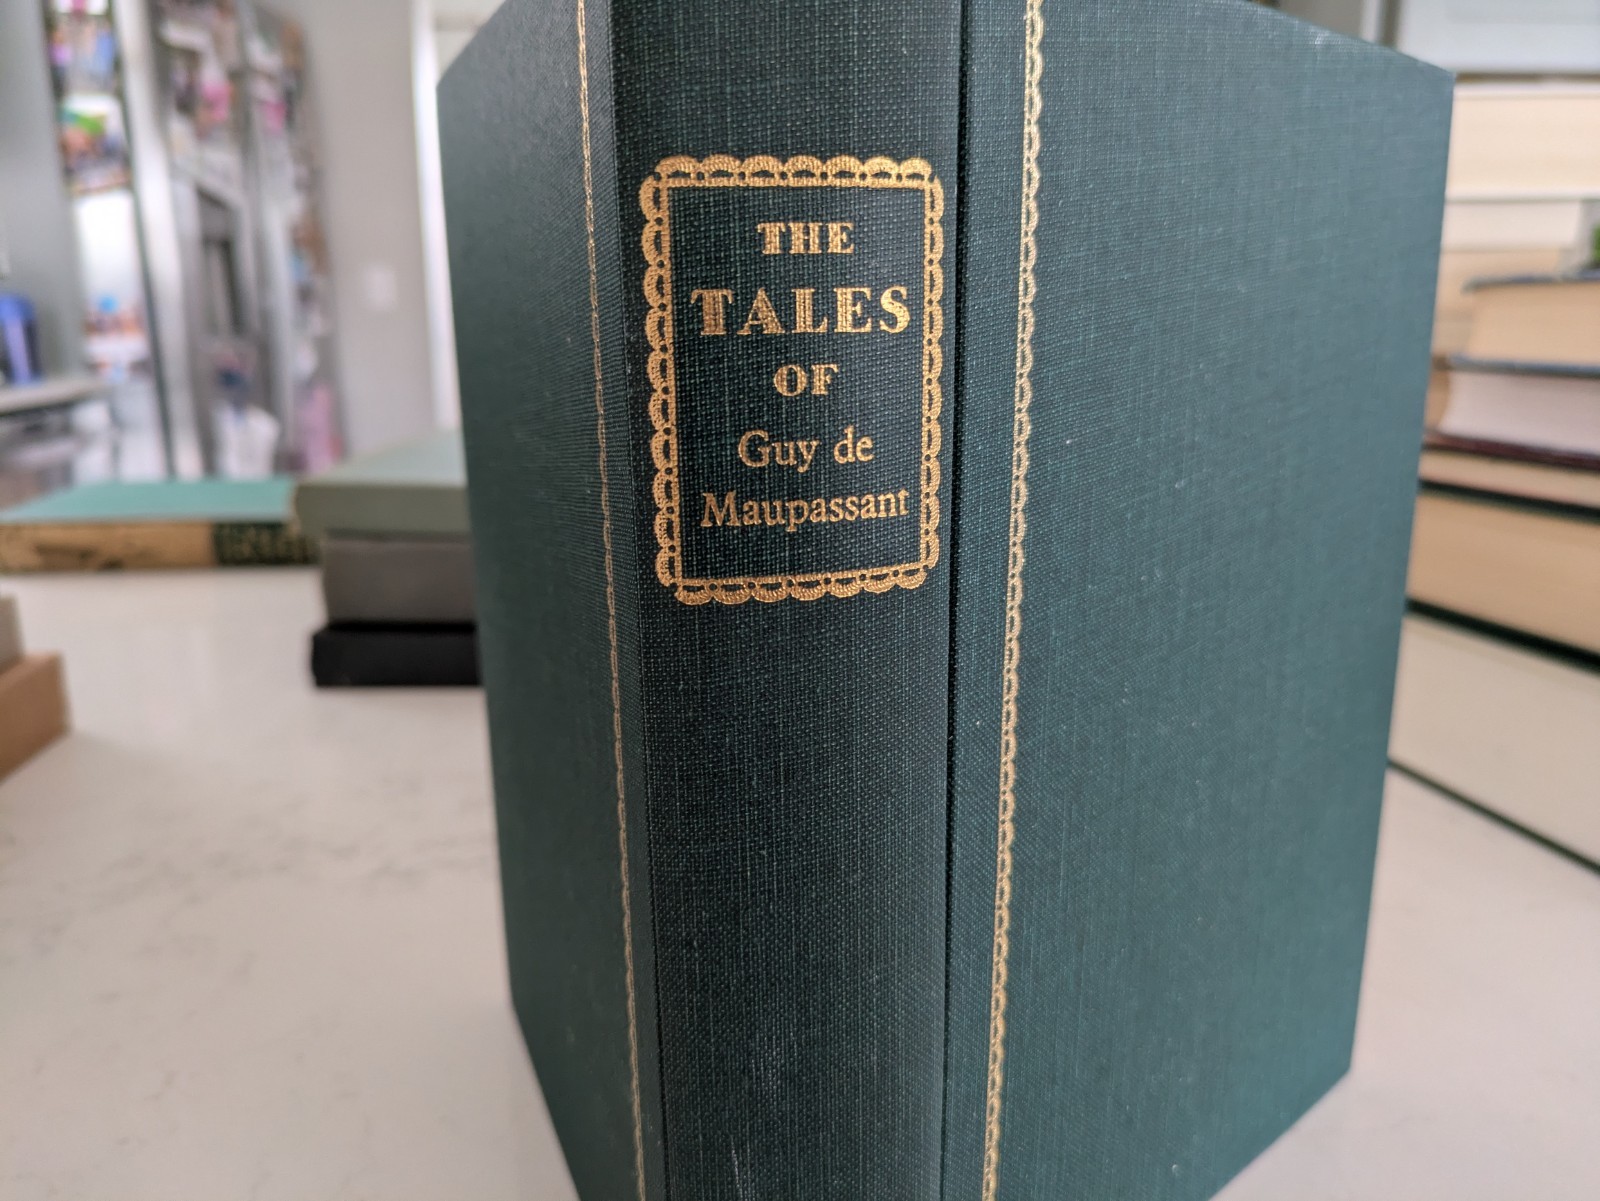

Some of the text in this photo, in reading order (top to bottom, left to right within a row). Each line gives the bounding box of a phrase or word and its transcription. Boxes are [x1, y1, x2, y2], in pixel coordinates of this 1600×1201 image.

[757, 222, 854, 255] THE
[691, 285, 911, 336] TALES
[773, 363, 839, 397] OF
[737, 425, 875, 473] Guy de
[699, 489, 910, 532] Maupassant
